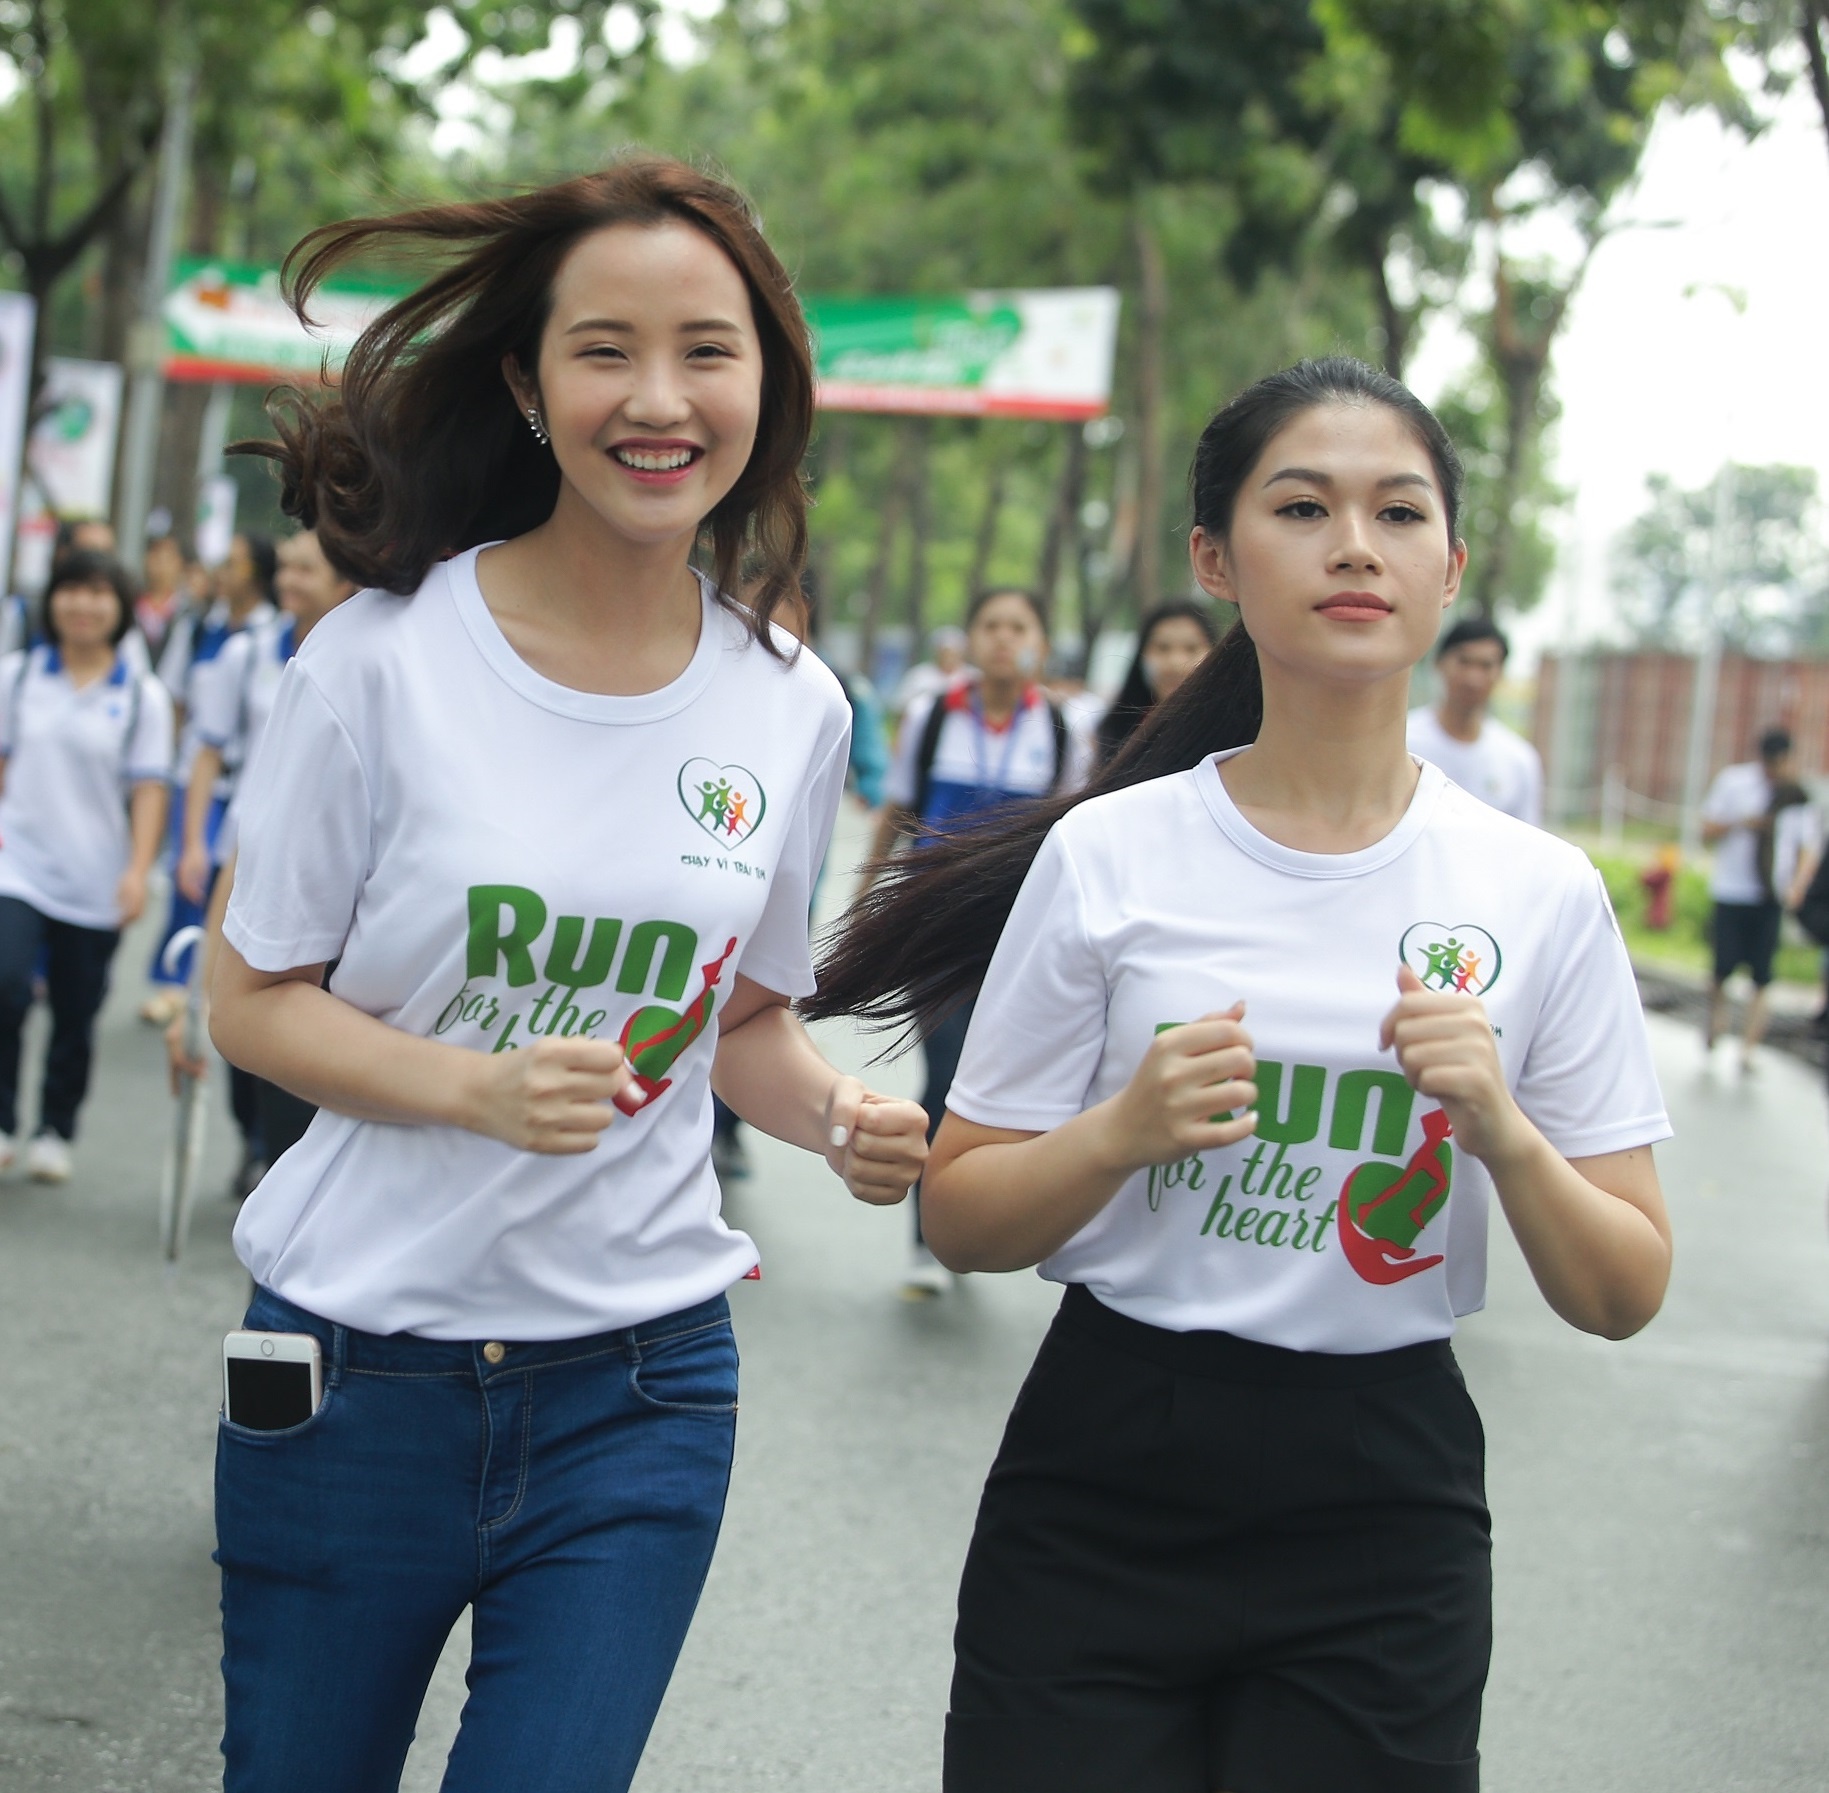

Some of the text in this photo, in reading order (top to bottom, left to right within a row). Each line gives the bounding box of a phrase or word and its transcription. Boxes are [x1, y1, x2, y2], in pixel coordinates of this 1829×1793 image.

[467, 884, 698, 1002] Run
[527, 984, 607, 1039] the
[1154, 1022, 1416, 1157] un
[1240, 1141, 1322, 1202] the
[1200, 1174, 1340, 1253] heart
